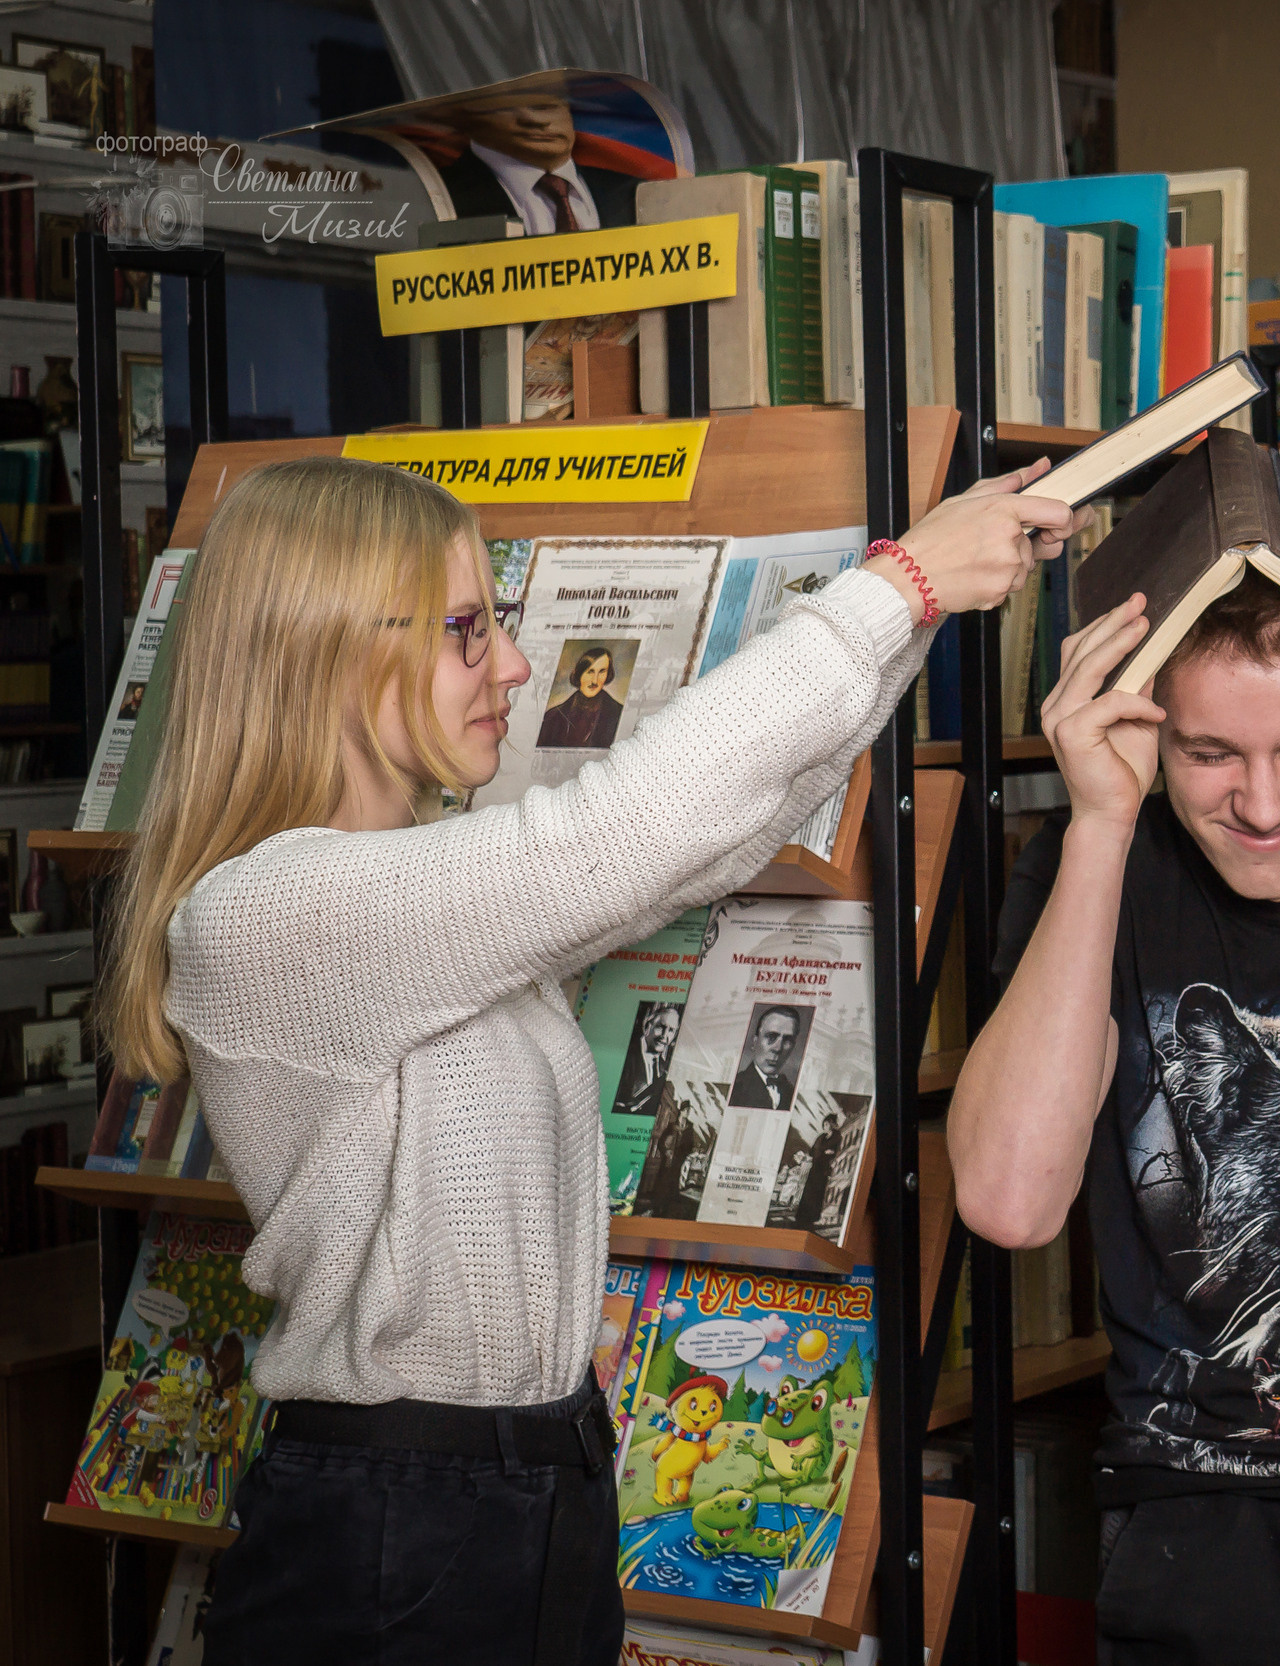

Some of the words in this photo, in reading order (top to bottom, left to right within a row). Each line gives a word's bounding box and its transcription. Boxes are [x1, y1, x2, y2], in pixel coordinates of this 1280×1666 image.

[392, 268, 495, 305] РУССКАЯ
[502, 250, 654, 293] ЛИТЕРАТУРА
[697, 242, 720, 269] В.
[493, 457, 551, 487] ДЛЯ
[553, 447, 688, 482] УЧИТЕЛЕЙ
[556, 586, 606, 601] Николай
[608, 586, 679, 601] Васильевич
[587, 605, 631, 620] ГОГОЛЬ
[140, 634, 162, 643] ГЕНЕР
[606, 950, 680, 965] АЛЕКСАНДР
[681, 954, 700, 965] МЕ
[731, 953, 779, 968] Михаил
[780, 954, 863, 972] Афанасьевич
[656, 968, 695, 981] ВОЛК
[755, 970, 829, 986] БУЛГАКОВ
[152, 1212, 257, 1262] Мурзи
[675, 1261, 874, 1321] Мурзилка
